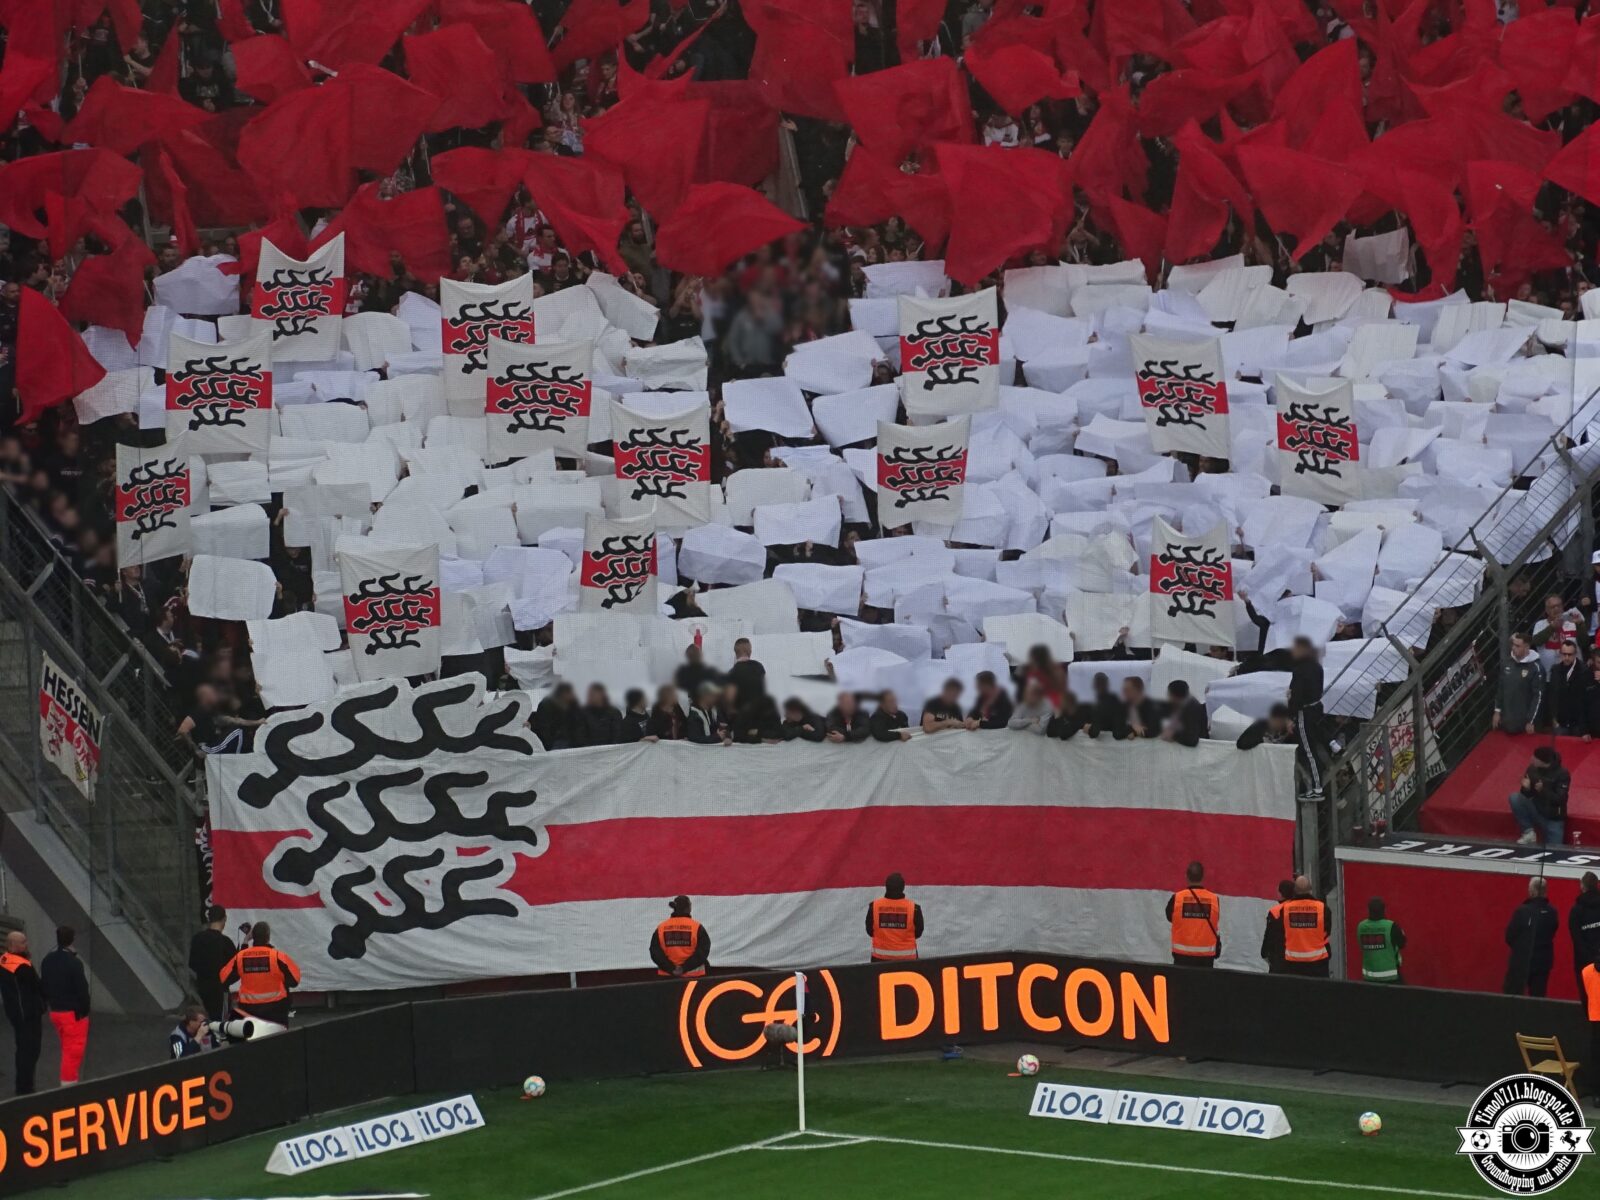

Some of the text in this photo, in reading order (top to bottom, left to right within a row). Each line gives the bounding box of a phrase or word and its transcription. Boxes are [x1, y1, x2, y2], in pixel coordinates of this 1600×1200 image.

[44, 665, 99, 743] HESSEN
[879, 962, 1169, 1043] DITCON
[23, 1071, 233, 1168] SERVICES
